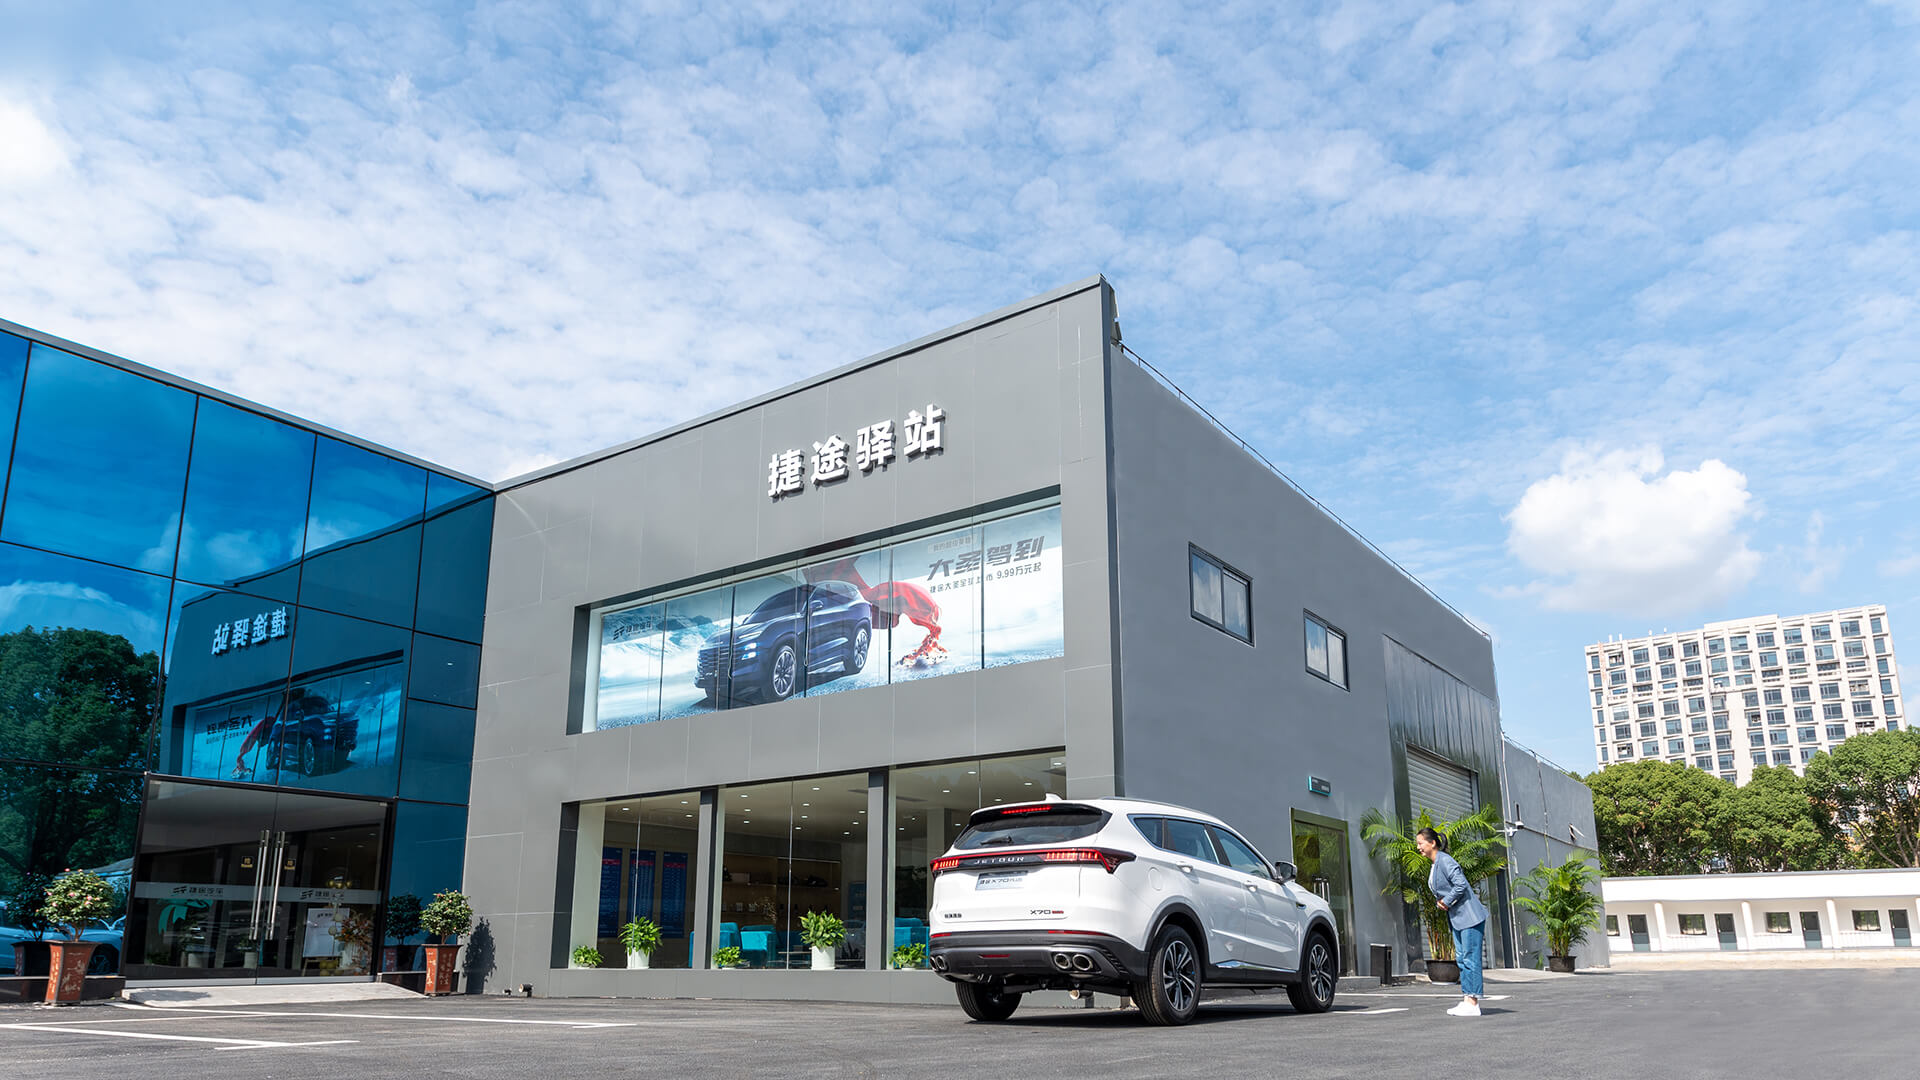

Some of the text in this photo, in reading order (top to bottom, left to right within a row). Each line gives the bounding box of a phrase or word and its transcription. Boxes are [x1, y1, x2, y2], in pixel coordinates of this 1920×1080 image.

[768, 403, 945, 498] 捷途驿站
[926, 535, 1045, 582] 大圣驾到
[973, 856, 1025, 865] JETOUR
